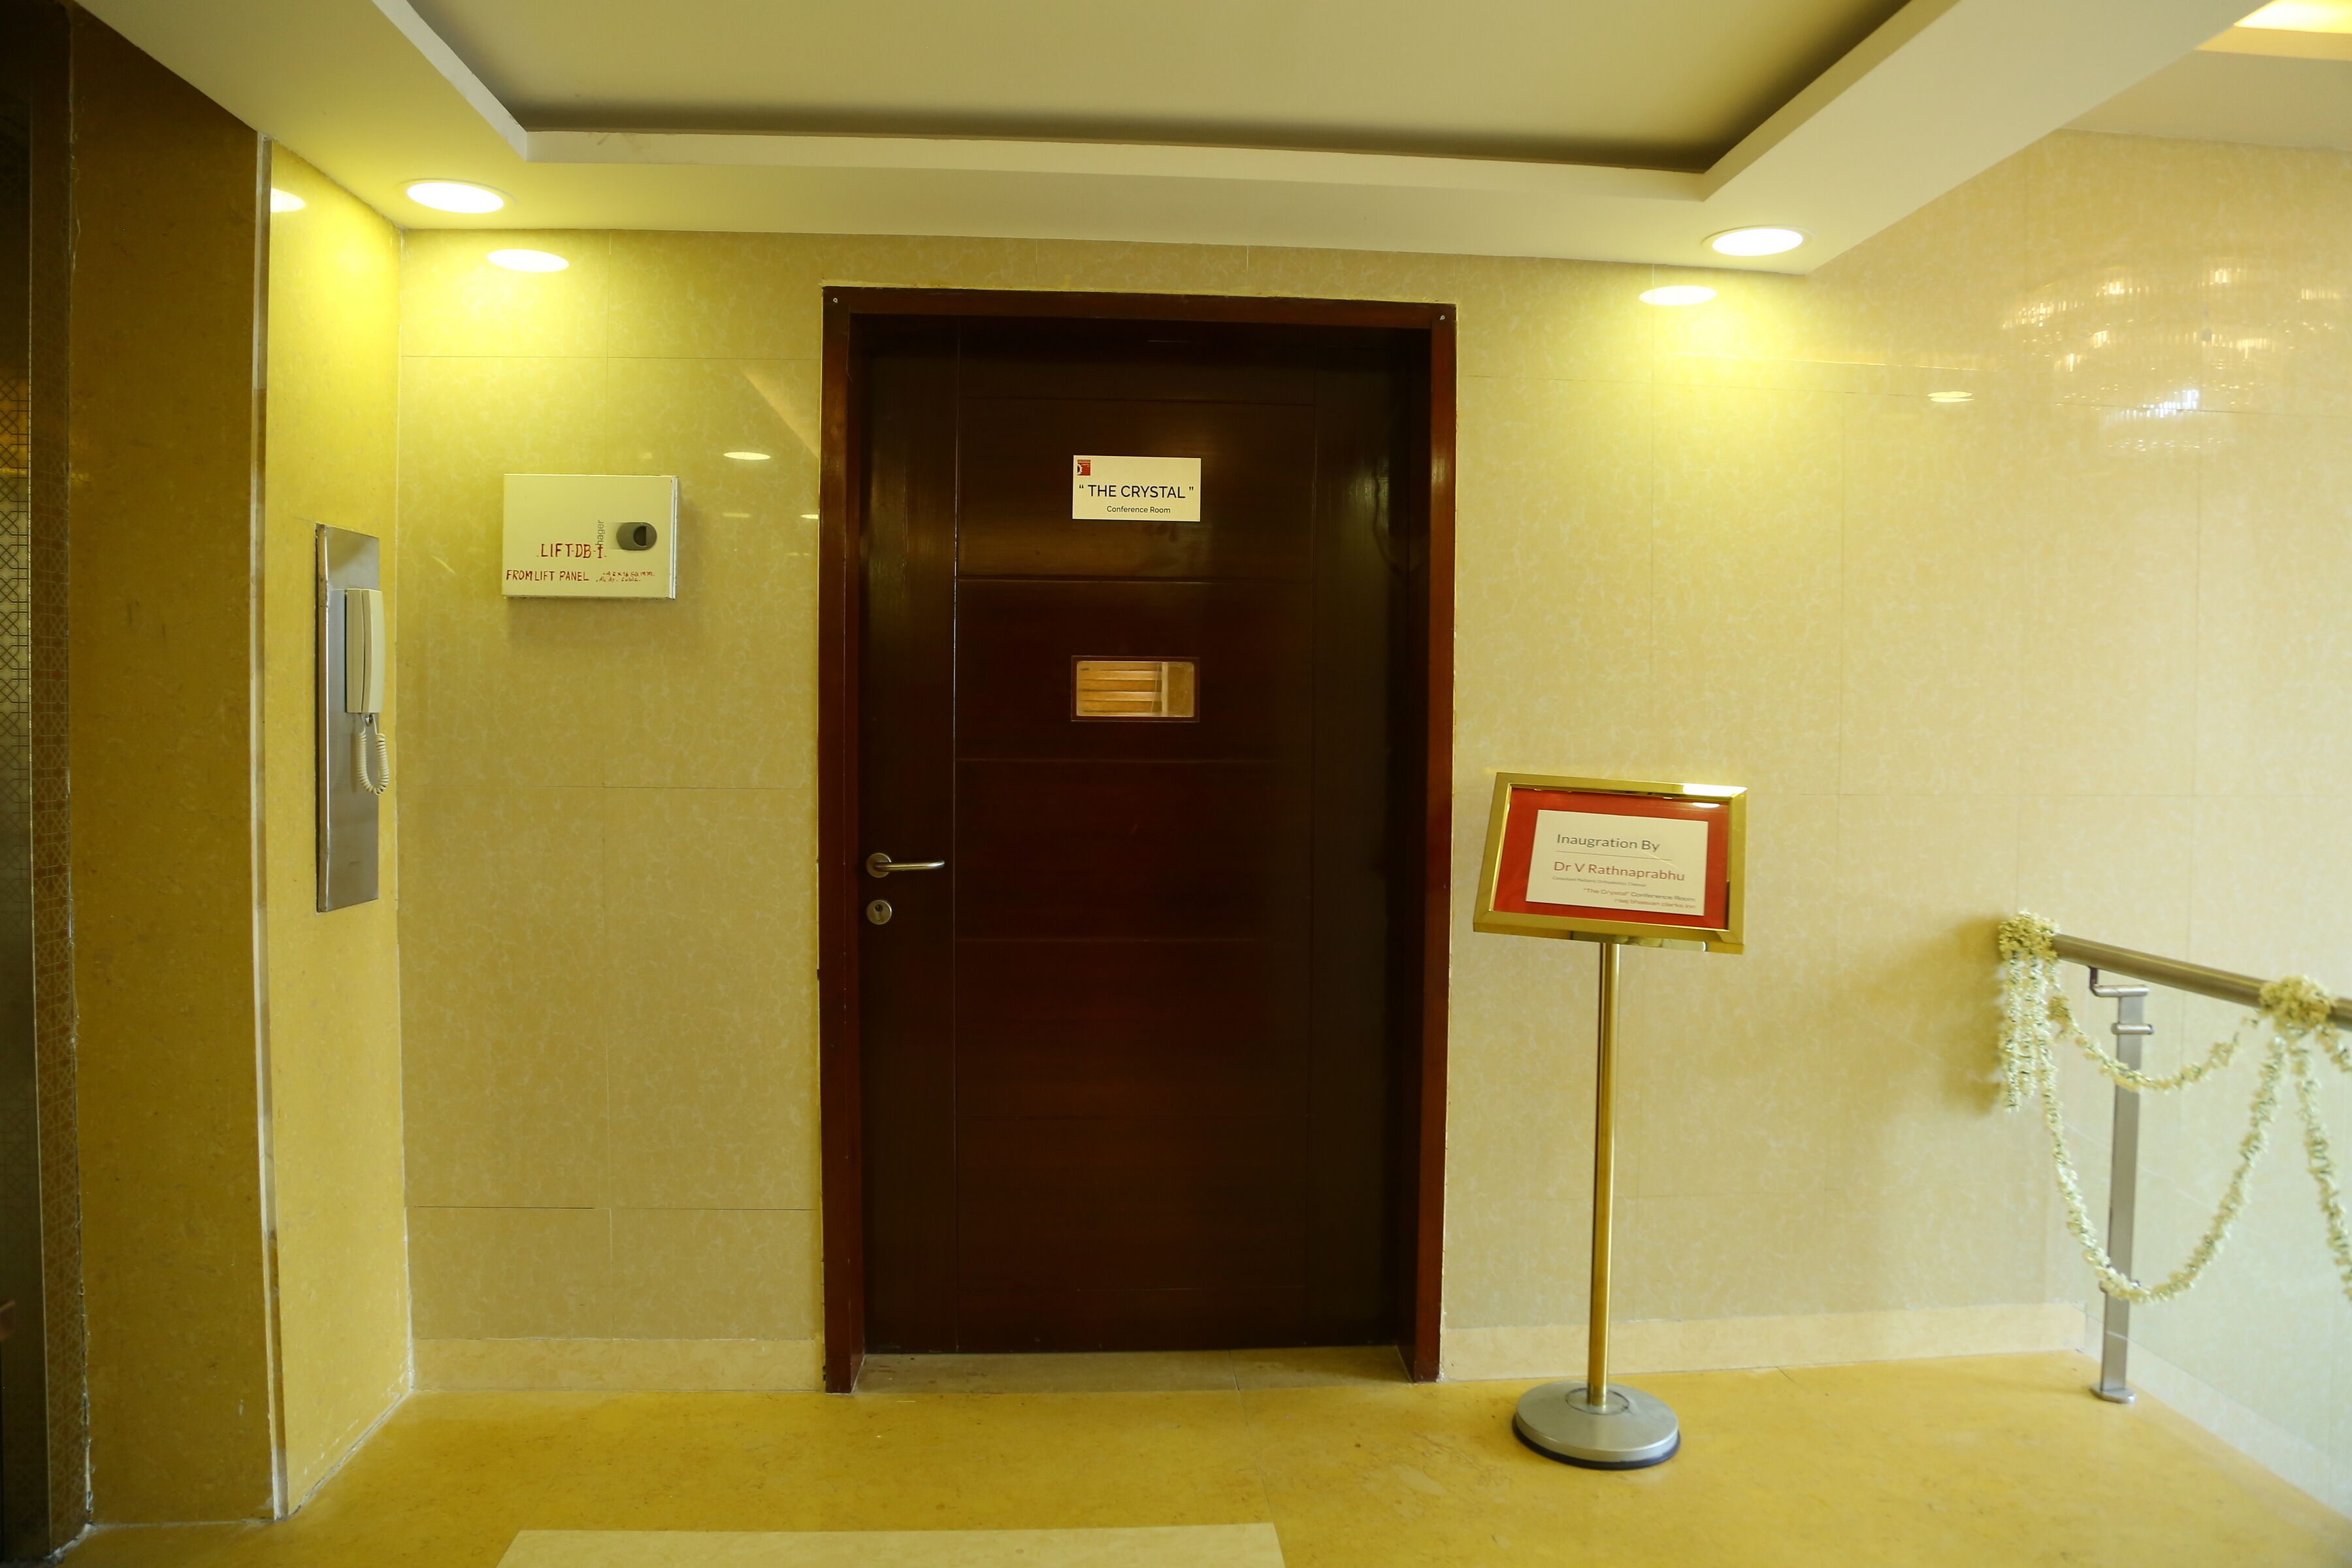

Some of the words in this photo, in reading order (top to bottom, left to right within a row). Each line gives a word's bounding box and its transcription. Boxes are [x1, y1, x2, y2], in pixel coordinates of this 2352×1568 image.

[1087, 485, 1117, 497] THE
[1120, 485, 1186, 498] CRYSTAL
[595, 520, 605, 547] hager
[506, 570, 532, 581] FROM
[534, 570, 555, 581] LIFT
[559, 571, 589, 581] PANEL
[1557, 834, 1637, 848] Inaugration
[1642, 840, 1660, 852] By
[1554, 861, 1571, 871] Dr
[1575, 863, 1585, 872] V
[1588, 864, 1685, 881] Rathnaprabhu
[1631, 891, 1673, 900] Conference
